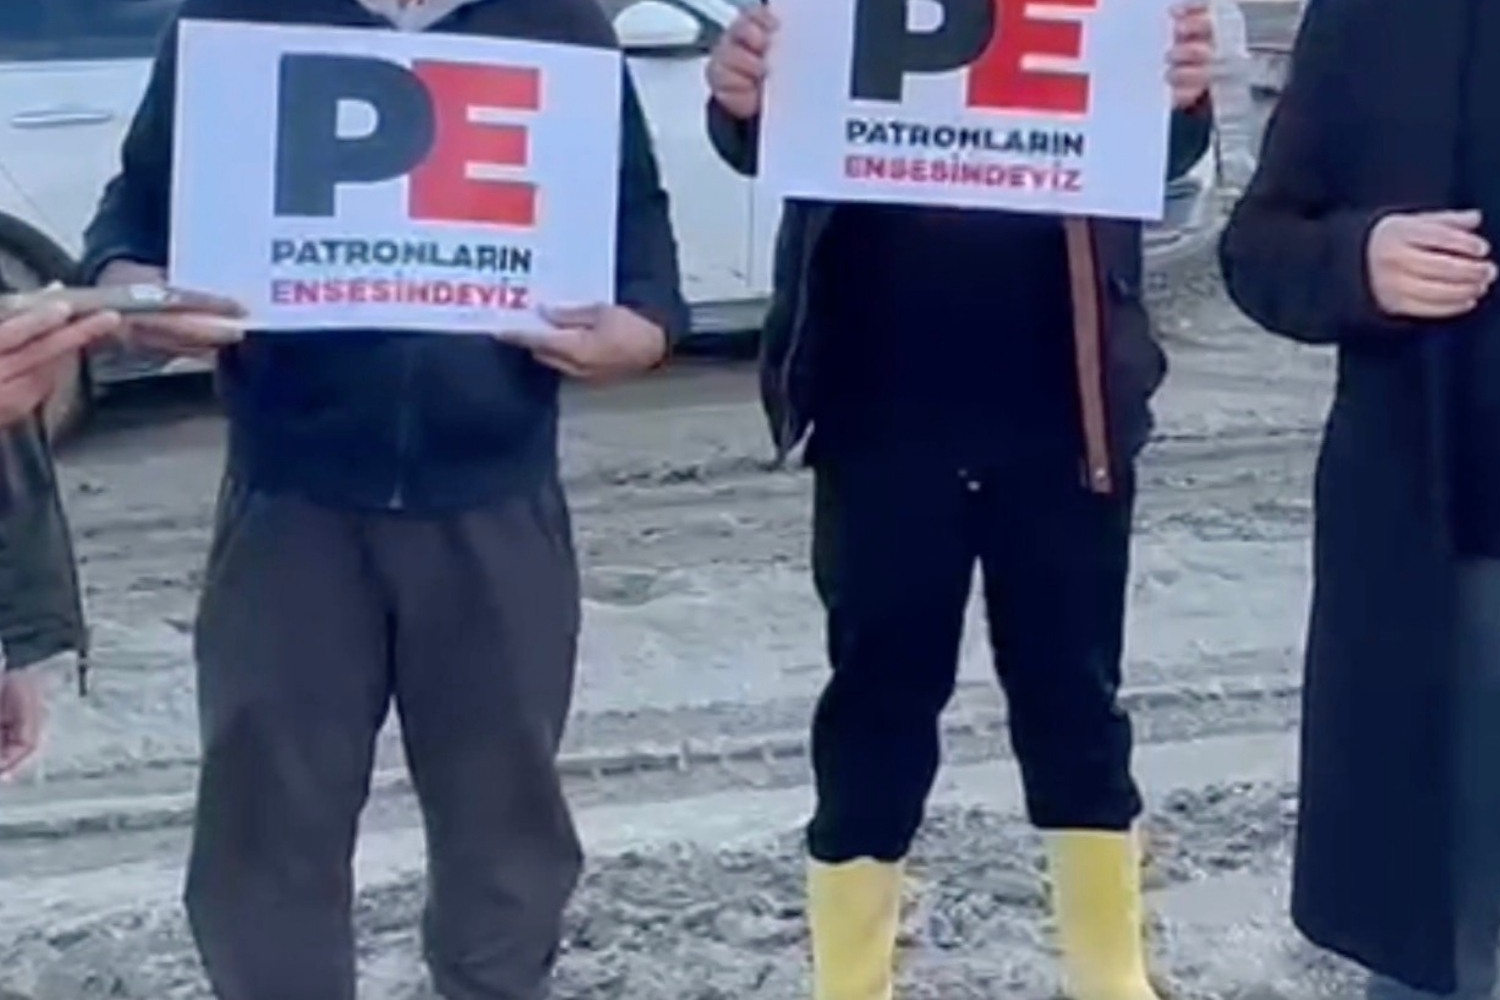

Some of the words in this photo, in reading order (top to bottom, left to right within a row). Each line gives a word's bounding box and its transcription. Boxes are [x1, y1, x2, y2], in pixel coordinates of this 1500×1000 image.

[273, 52, 541, 227] PE
[844, 119, 1085, 157] PATRONLARIN
[271, 238, 533, 274] PATRONLARIN
